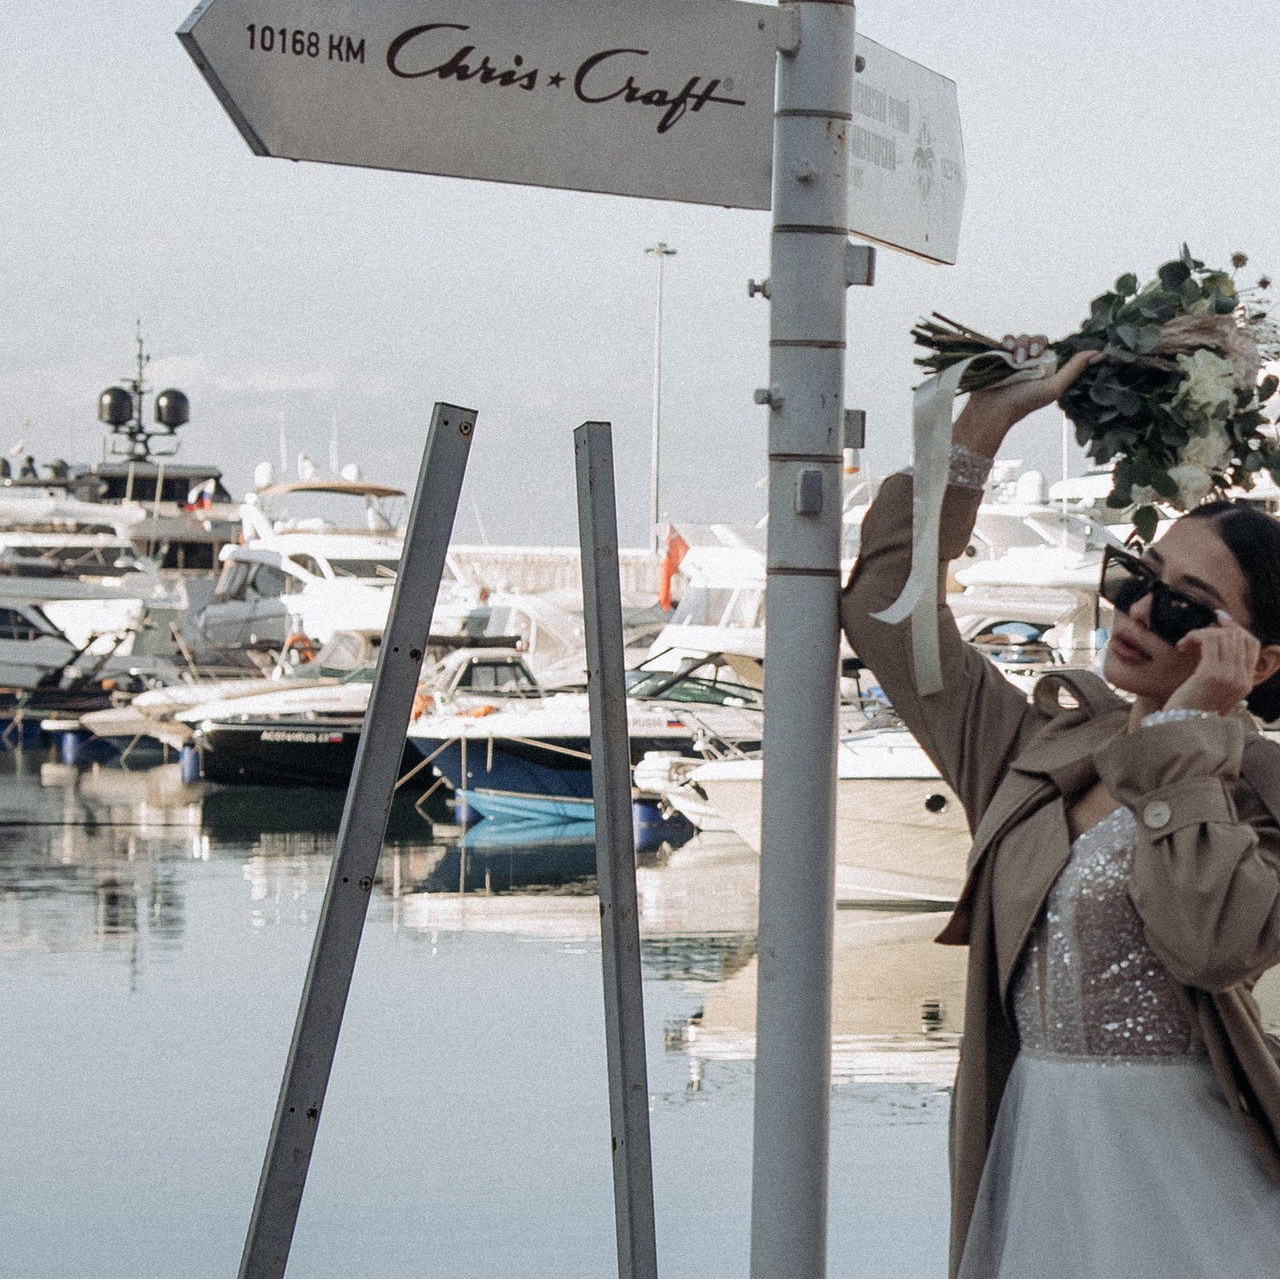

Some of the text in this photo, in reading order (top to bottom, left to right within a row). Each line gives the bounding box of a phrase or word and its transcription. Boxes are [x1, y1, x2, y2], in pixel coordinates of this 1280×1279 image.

[246, 23, 320, 58] 10168
[386, 23, 746, 134] Chris Craft
